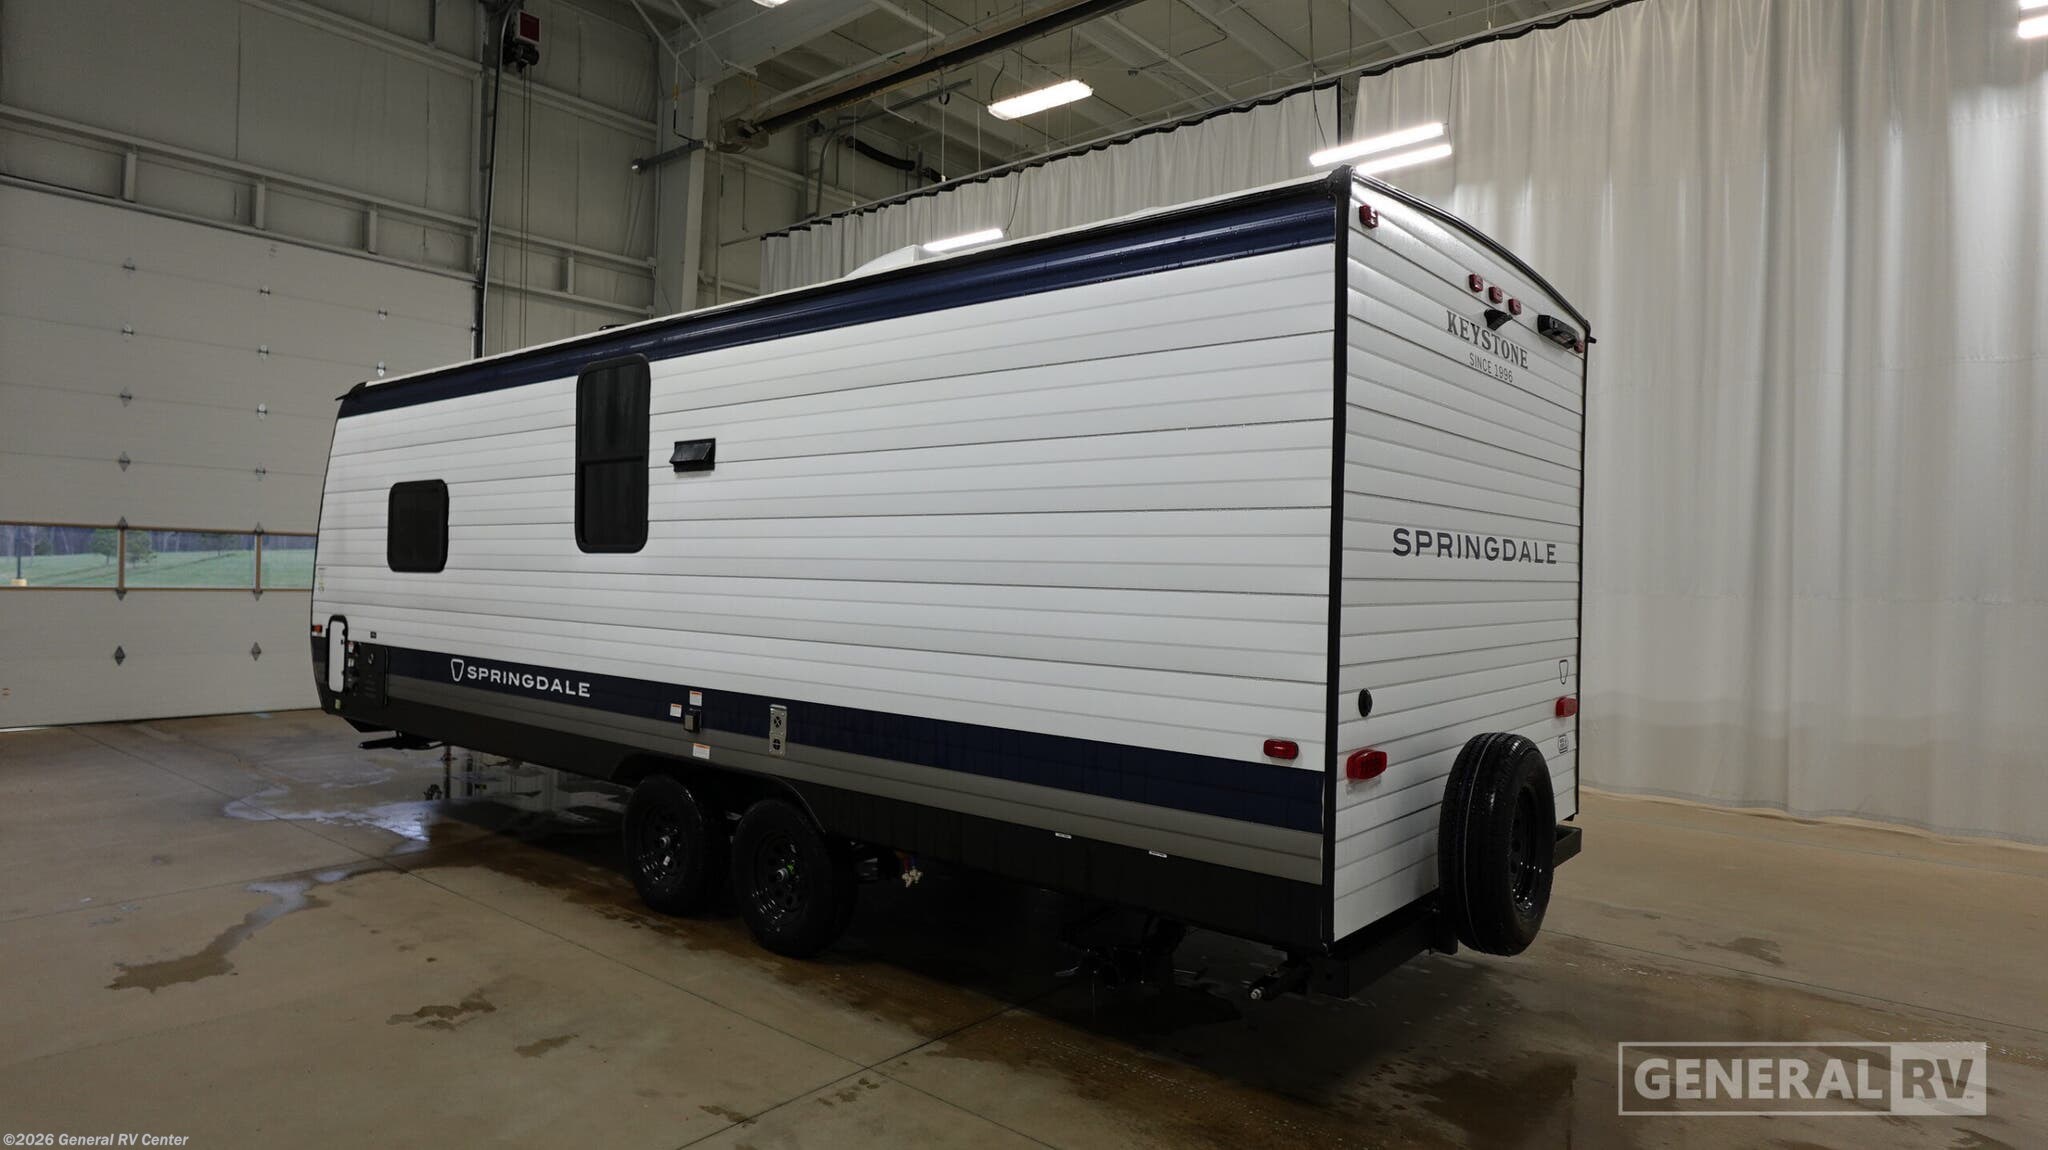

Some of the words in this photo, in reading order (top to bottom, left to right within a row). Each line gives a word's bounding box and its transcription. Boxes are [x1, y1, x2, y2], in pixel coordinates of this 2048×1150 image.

[1446, 310, 1529, 370] KEYSTONE
[1469, 352, 1492, 375] SINCE
[1494, 363, 1514, 383] 1996
[1392, 527, 1558, 565] SPRINGDALE
[466, 665, 591, 698] SPRINGDALE
